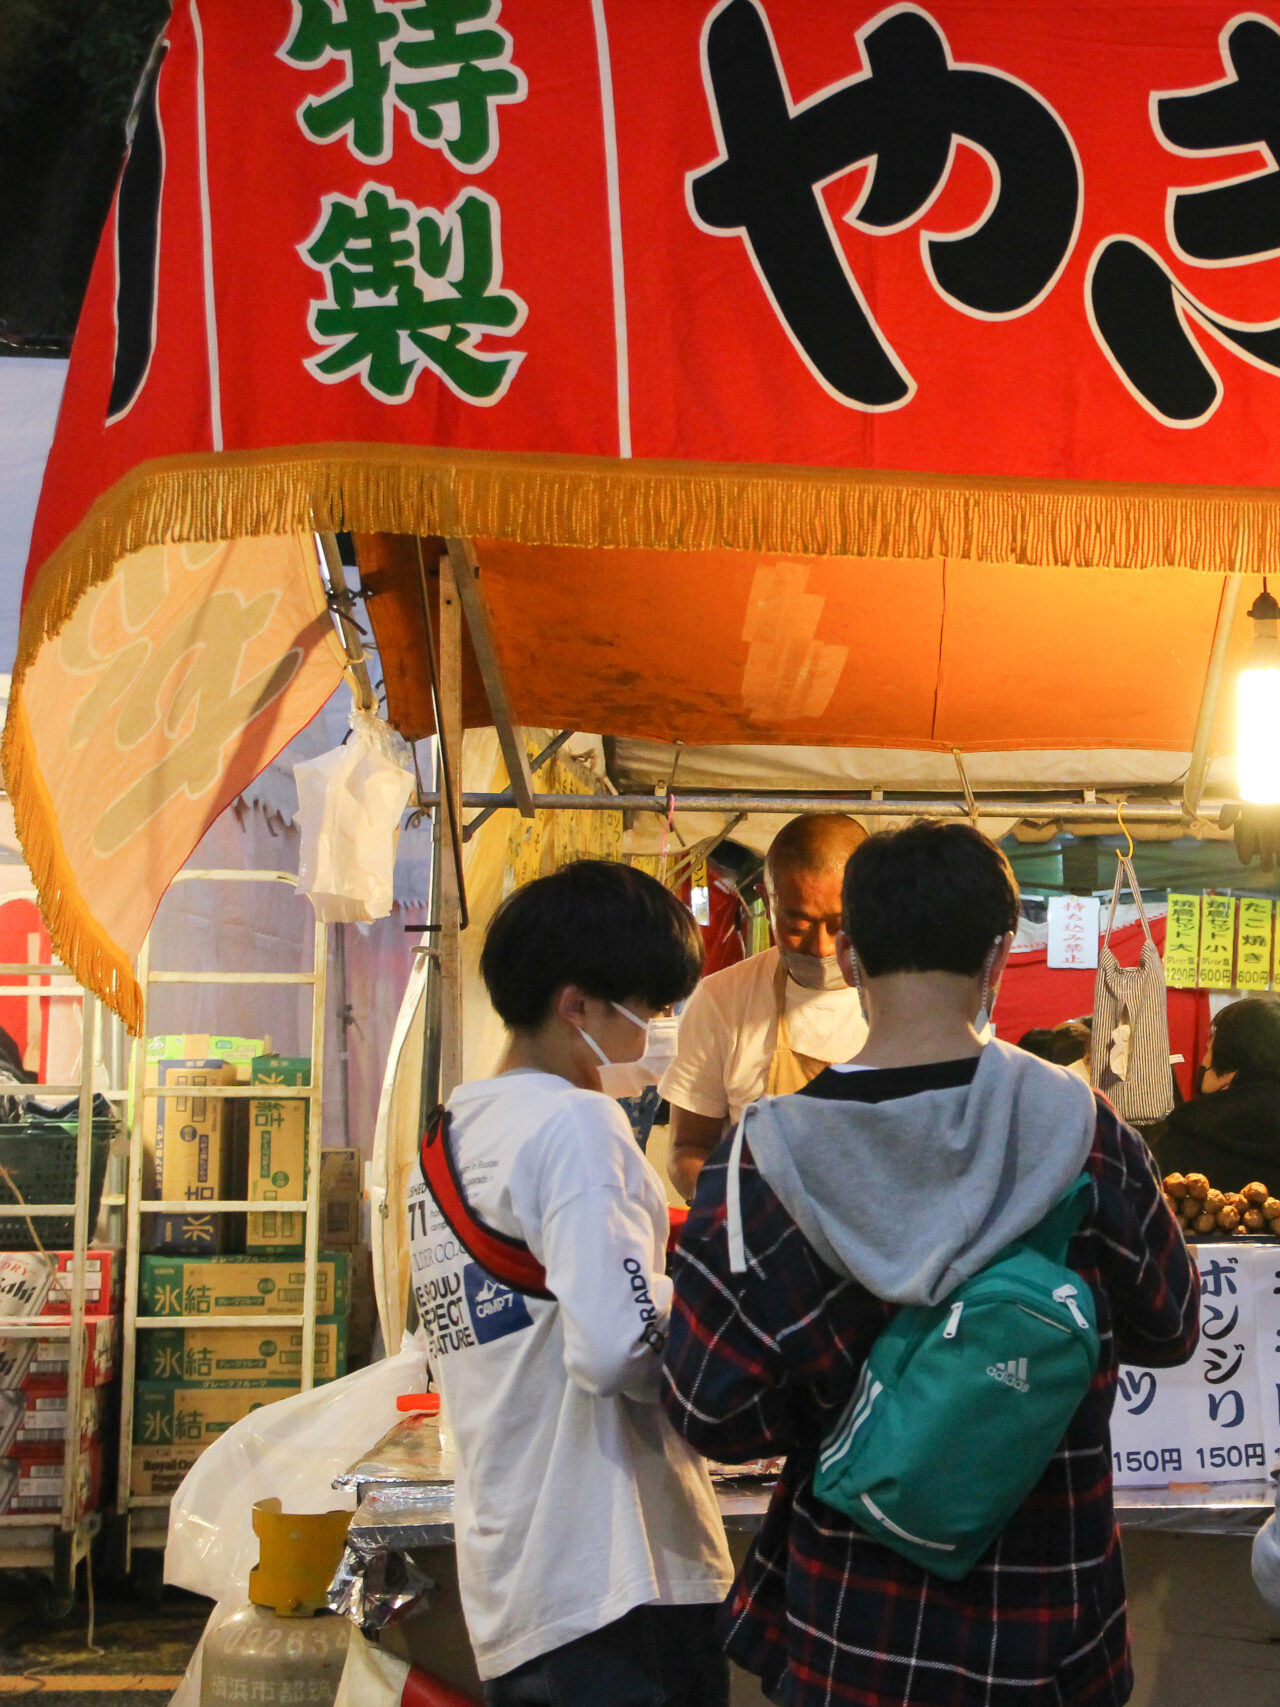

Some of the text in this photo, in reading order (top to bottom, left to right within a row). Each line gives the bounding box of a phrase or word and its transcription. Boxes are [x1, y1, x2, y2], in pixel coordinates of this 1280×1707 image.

[278, 0, 528, 406] 特製
[1242, 902, 1267, 964] たこ焼き
[1238, 970, 1269, 985] 600円
[154, 1284, 214, 1315] 氷結
[154, 1347, 214, 1378] 氷結
[986, 1366, 1030, 1393] adidas
[1118, 1370, 1157, 1416] ツ
[145, 1410, 202, 1440] 氷結
[1113, 1447, 1183, 1473] 150円
[1196, 1442, 1267, 1469] 150円
